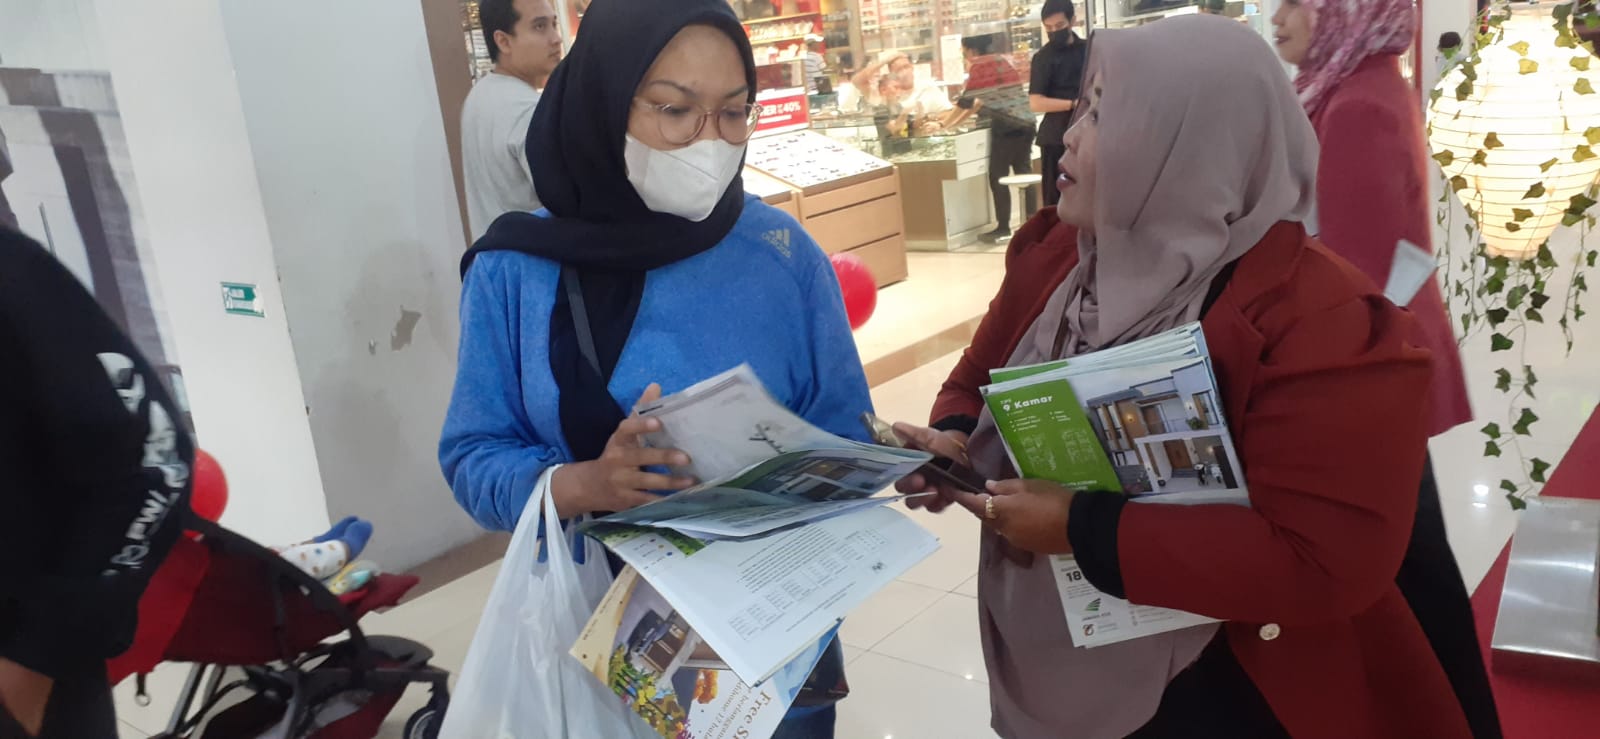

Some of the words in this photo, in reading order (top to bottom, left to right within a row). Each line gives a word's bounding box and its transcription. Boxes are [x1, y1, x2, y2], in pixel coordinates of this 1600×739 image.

[784, 101, 801, 112] 40%
[1003, 404, 1011, 412] 9
[1014, 395, 1053, 409] Kamar
[1066, 570, 1082, 582] 18
[744, 690, 772, 724] Free
